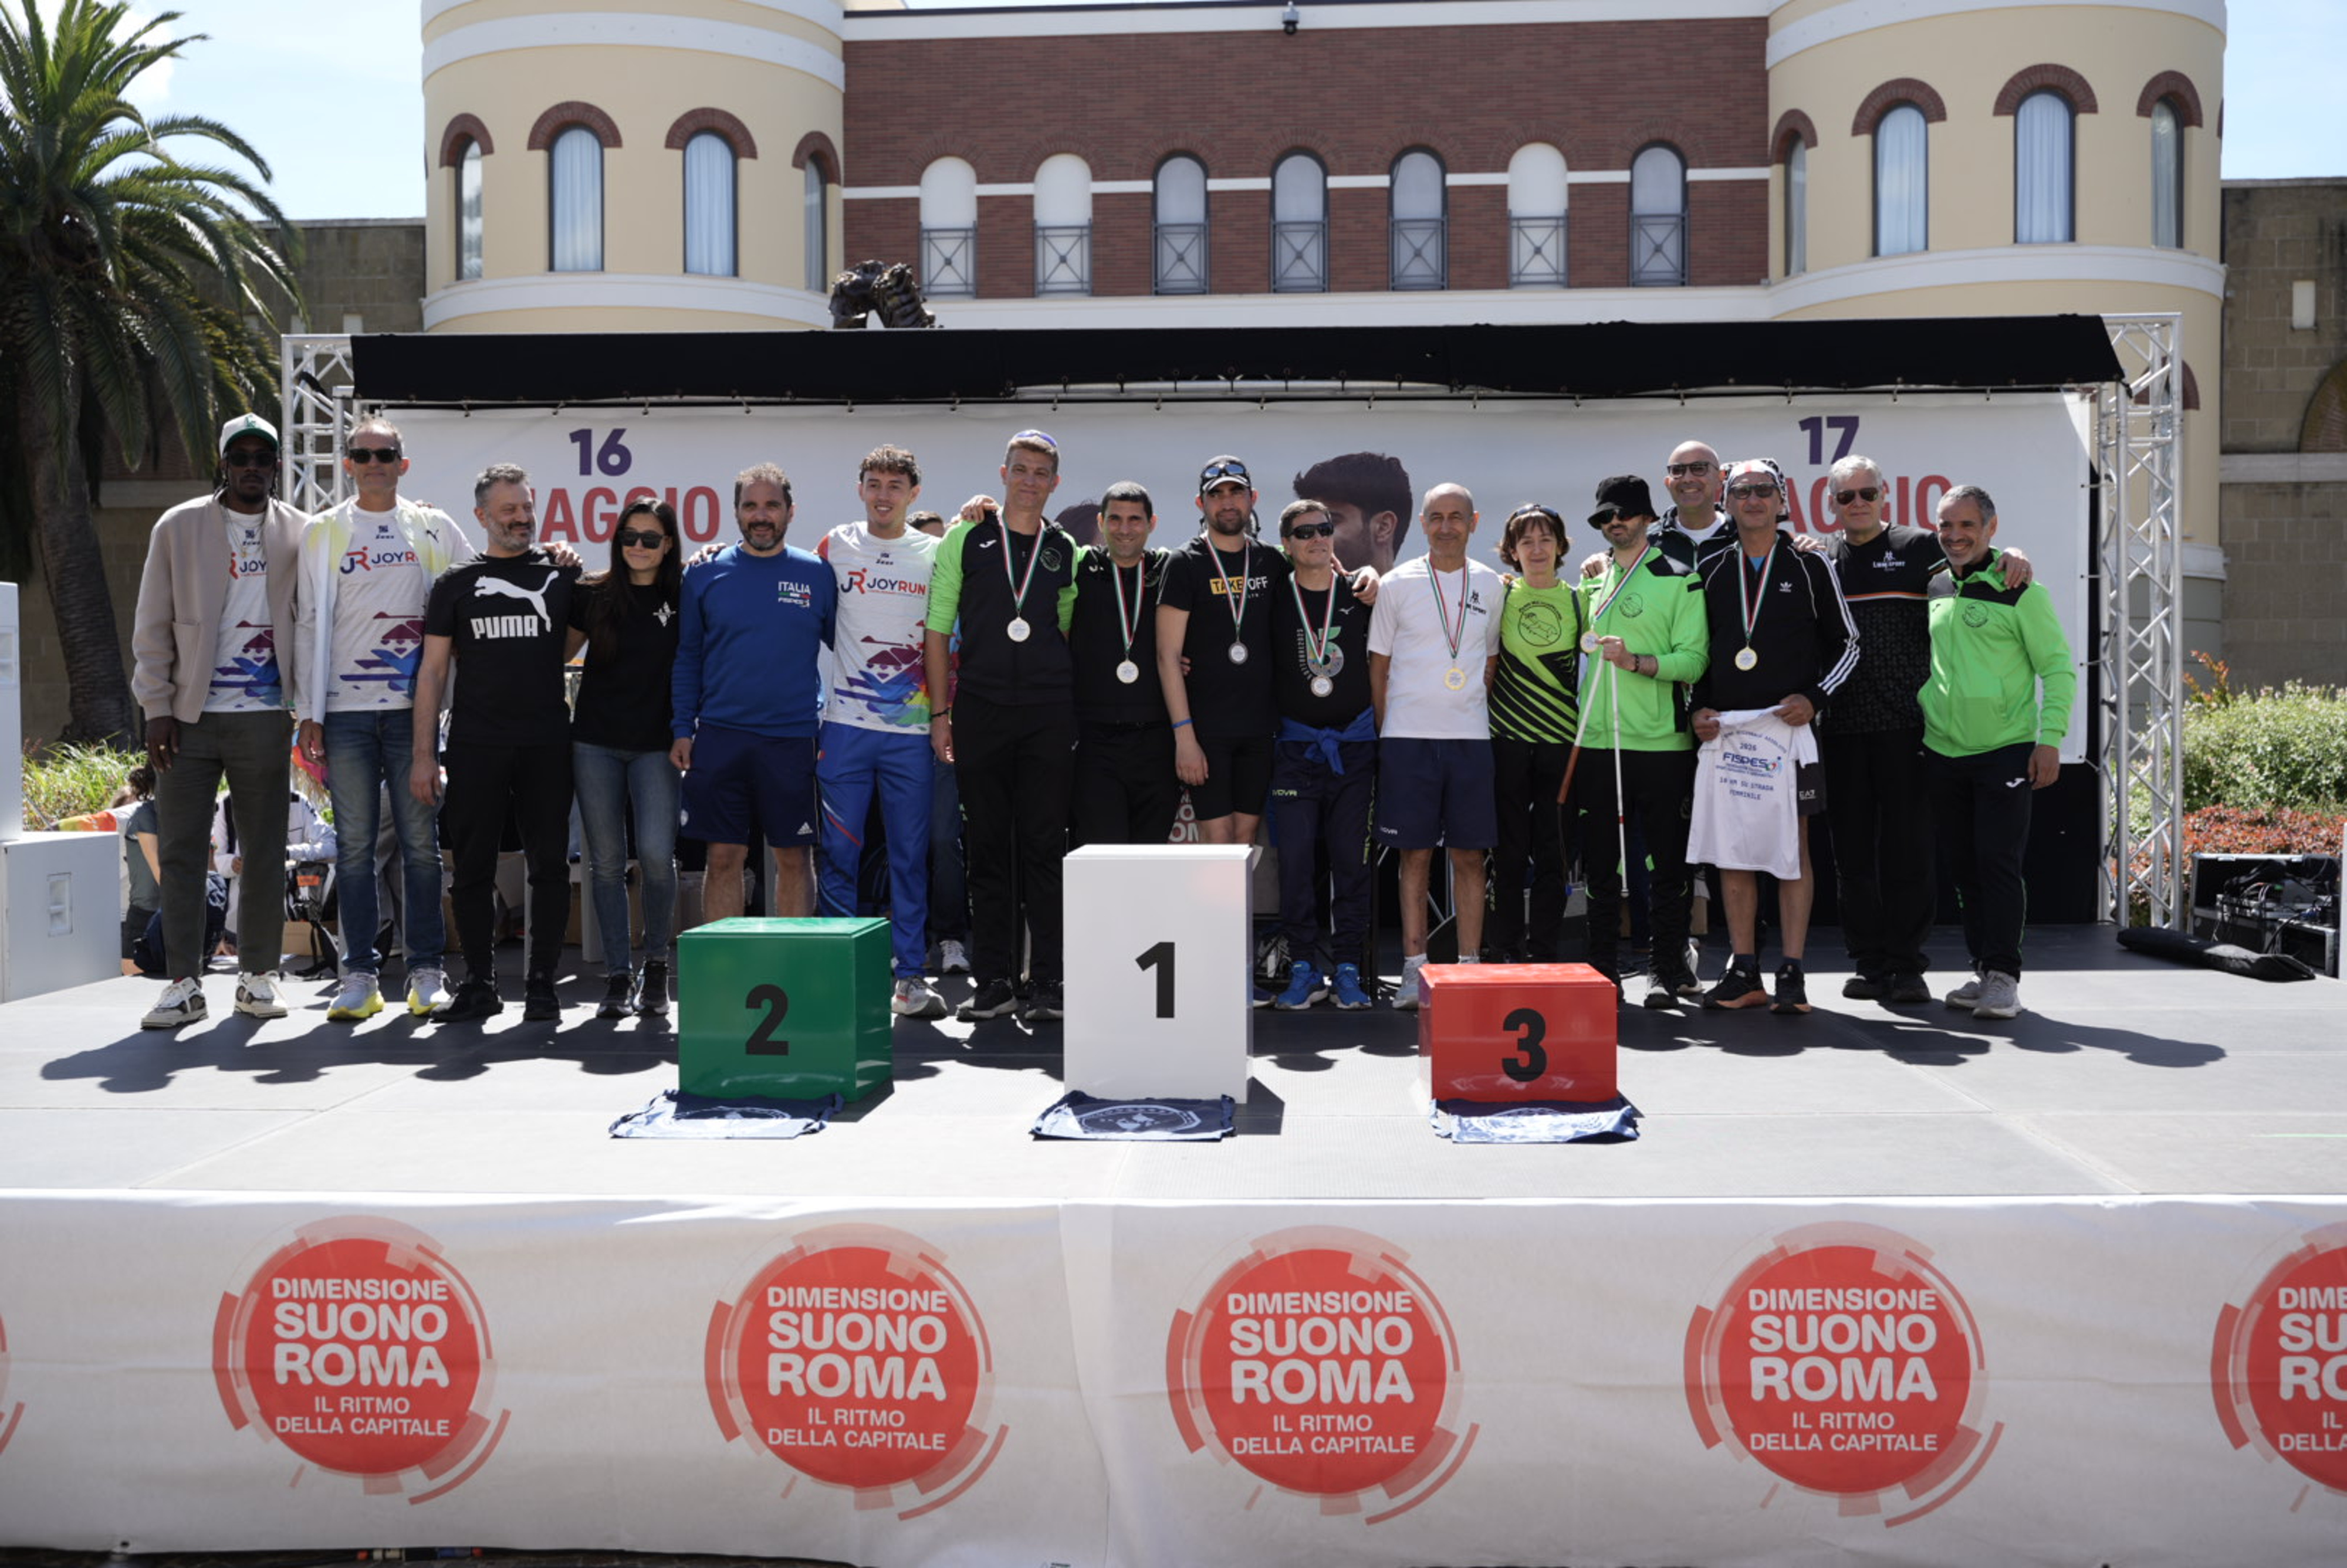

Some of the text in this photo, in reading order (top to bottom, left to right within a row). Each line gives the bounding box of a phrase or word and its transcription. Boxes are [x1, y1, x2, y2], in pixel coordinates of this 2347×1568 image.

[569, 428, 632, 476] 16
[1798, 415, 1859, 465] 17
[371, 551, 418, 564] JOYR
[778, 581, 811, 595] ITALIA
[867, 577, 926, 595] JOYRUN
[1247, 576, 1268, 590] OFF
[471, 615, 538, 639] PUMA
[1723, 752, 1768, 768] FISPES
[1135, 942, 1175, 1019] 1
[745, 984, 789, 1056] 2
[1502, 1008, 1547, 1082] 3
[273, 1278, 448, 1301] DIMENSIONE
[768, 1287, 947, 1312] DIMENSIONE
[1749, 1288, 1937, 1312] DIMENSIONE
[1227, 1291, 1413, 1315] DIMENSIONE
[275, 1302, 448, 1342] SUONO
[769, 1311, 947, 1353] SUONO
[1750, 1313, 1937, 1353] SUONO
[1231, 1316, 1414, 1356] SUONO
[275, 1343, 450, 1387] ROMA
[769, 1353, 947, 1401] ROMA
[1232, 1359, 1415, 1404] ROMA
[1751, 1356, 1939, 1401] ROMA
[316, 1396, 410, 1414] IL RITMO
[276, 1417, 450, 1436] DELLA CAPITALE
[809, 1408, 906, 1427] IL RITMO
[1274, 1415, 1374, 1432] IL RITMO
[1793, 1412, 1895, 1430] IL RITMO
[2323, 1411, 2343, 1429] IL
[769, 1428, 946, 1450] DELLA CAPITALE
[1234, 1436, 1415, 1454] DELLA CAPITALE
[1751, 1433, 1937, 1451] DELLA CAPITALE
